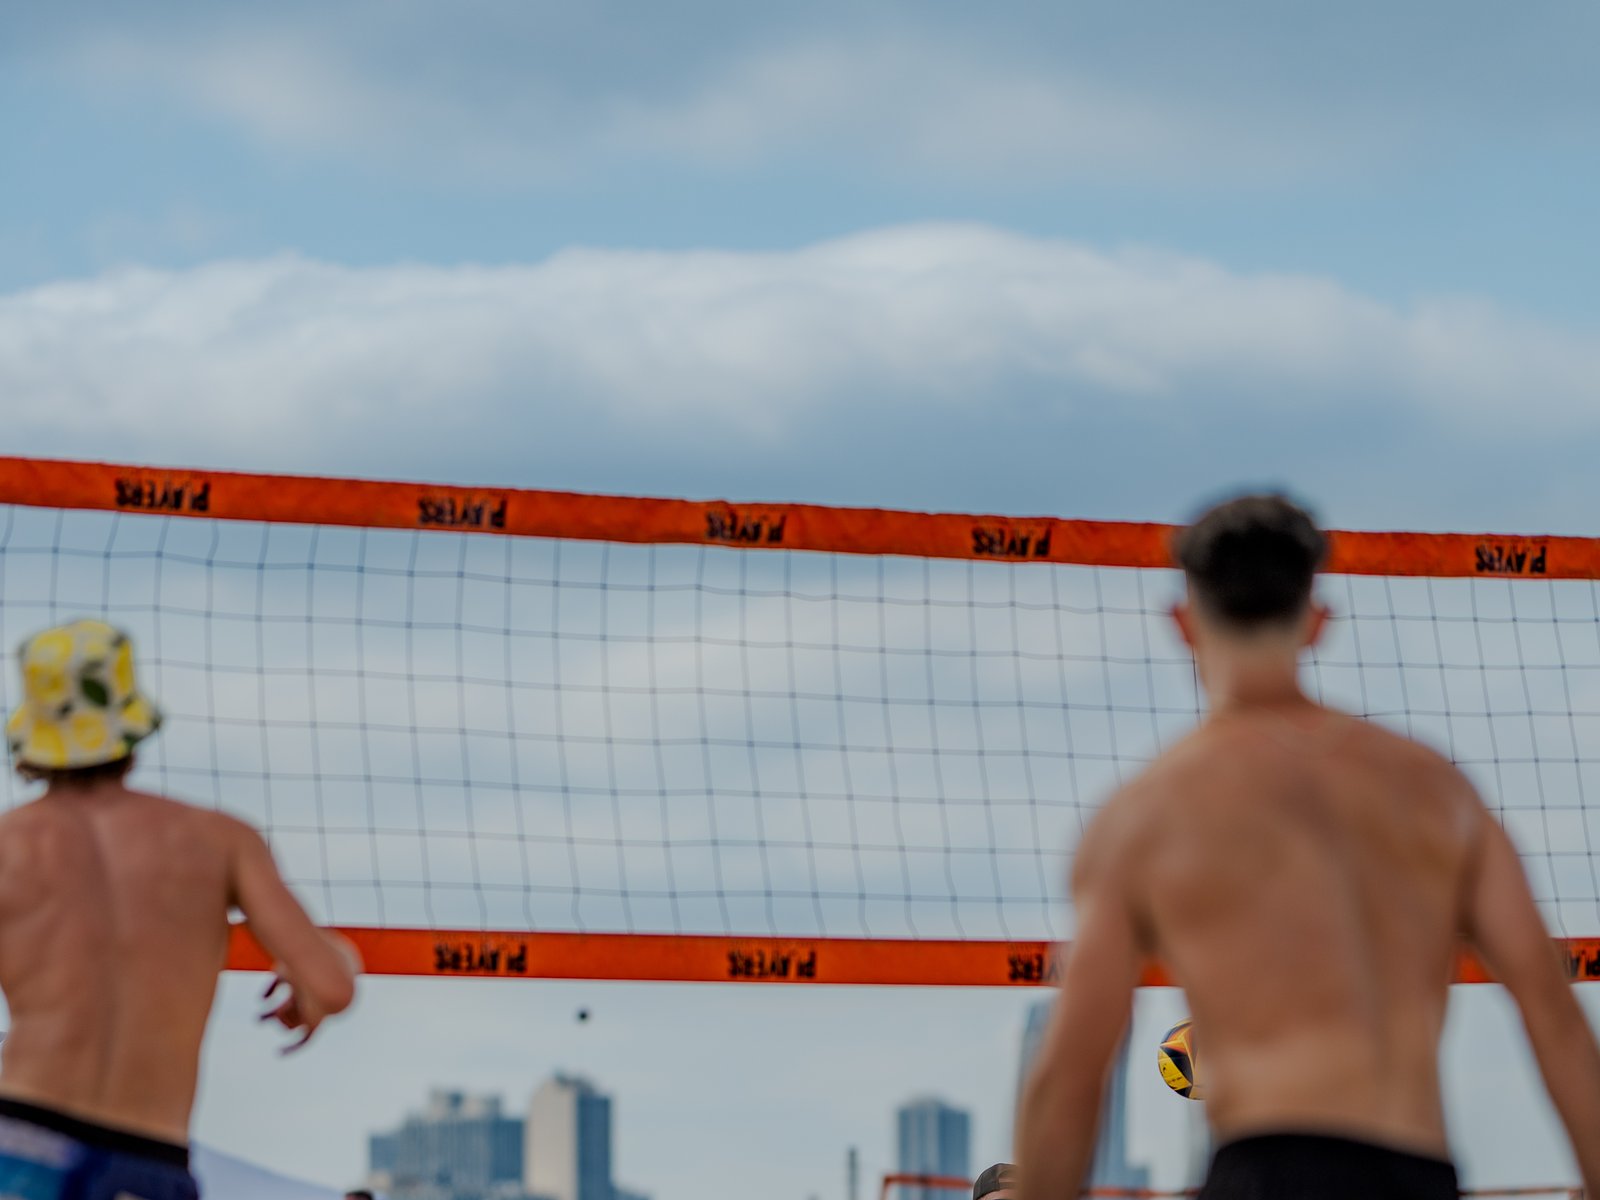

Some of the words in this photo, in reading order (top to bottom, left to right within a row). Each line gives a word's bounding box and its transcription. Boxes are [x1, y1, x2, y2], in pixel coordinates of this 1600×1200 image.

[115, 478, 210, 513] PLAYERS
[418, 494, 508, 529] PLAYERS
[705, 508, 788, 544] PLAYERS
[971, 524, 1051, 557] PLAYERS
[1475, 541, 1547, 574] PLAYERS
[434, 943, 527, 974] PLAYERS
[727, 950, 817, 980] PLAYERS
